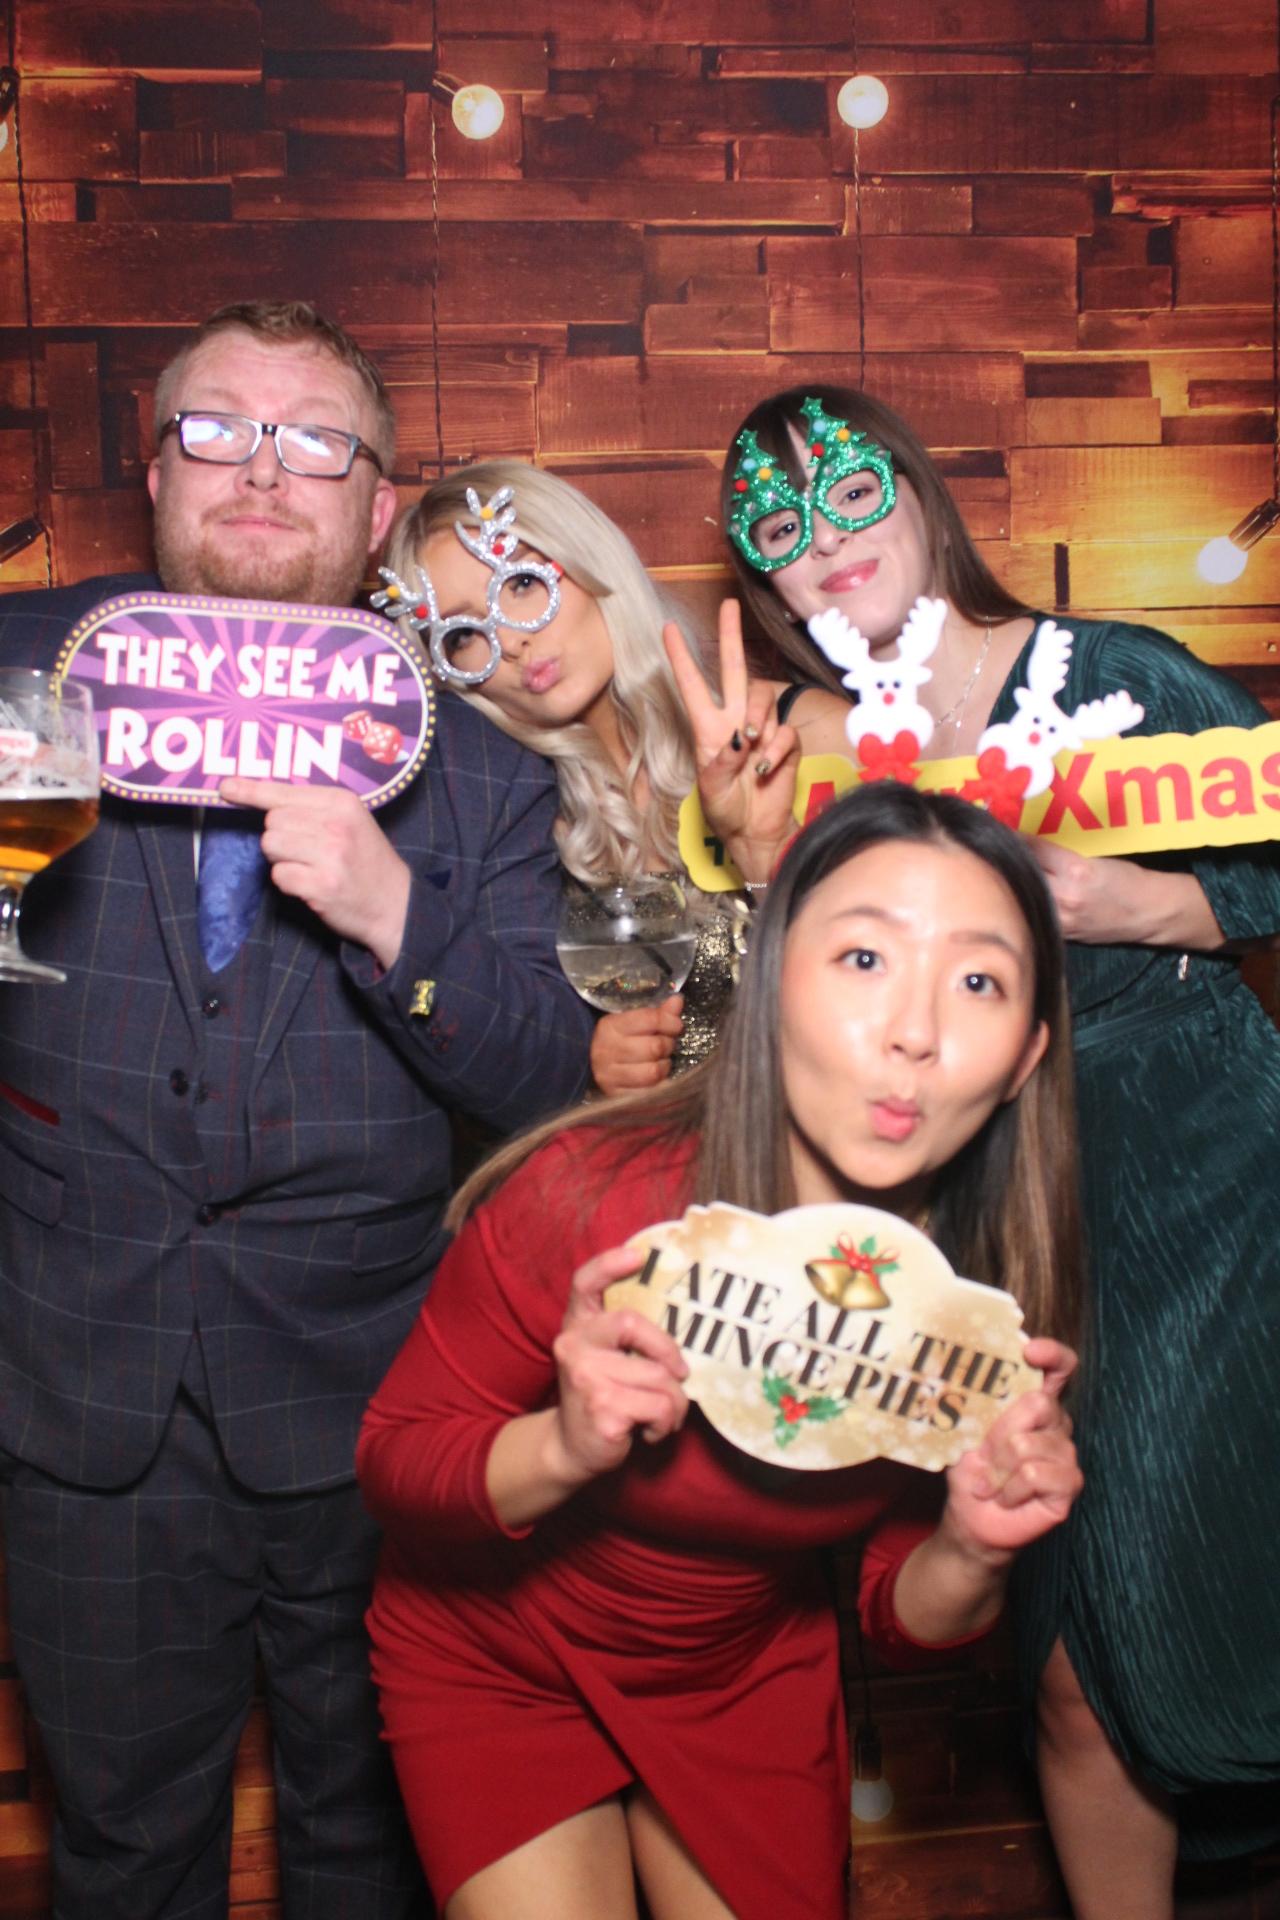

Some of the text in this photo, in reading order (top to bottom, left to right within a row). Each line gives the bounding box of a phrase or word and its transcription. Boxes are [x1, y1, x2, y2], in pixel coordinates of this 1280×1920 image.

[96, 632, 402, 707] THEY SEE ME
[105, 706, 344, 783] ROLLIN
[638, 1246, 1020, 1400] I ATE ALL THE
[660, 1303, 968, 1433] MINCE PIES
